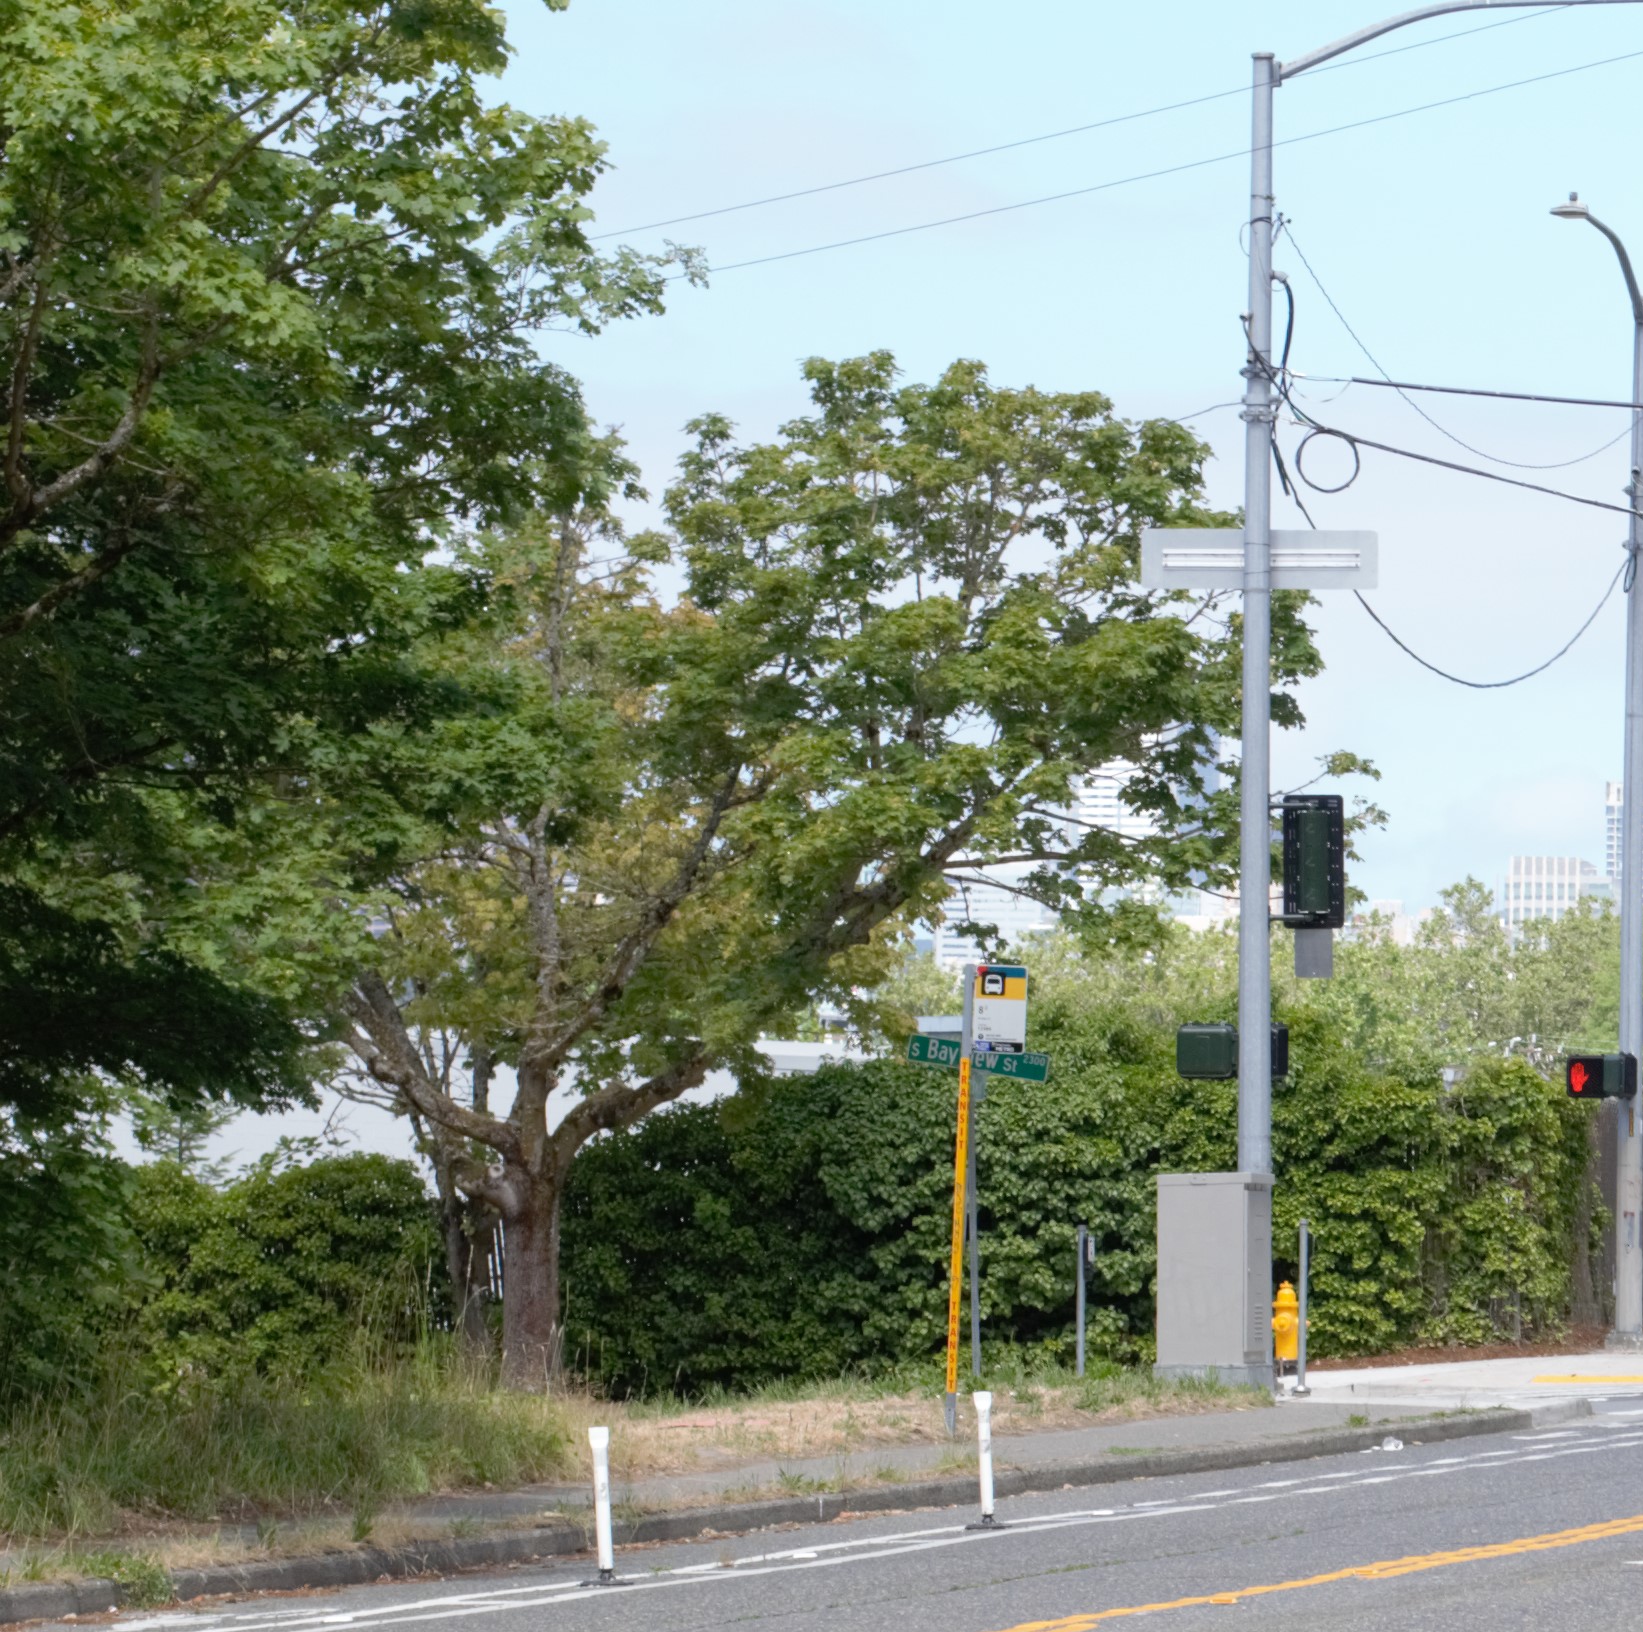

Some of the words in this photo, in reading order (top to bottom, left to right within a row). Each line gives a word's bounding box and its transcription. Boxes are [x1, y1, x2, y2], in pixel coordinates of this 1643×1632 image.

[1003, 1057, 1018, 1073] St
[1023, 1055, 1046, 1067] 2300
[957, 1062, 967, 1150] TRANSIT
[948, 1301, 957, 1389] TRANSIT
